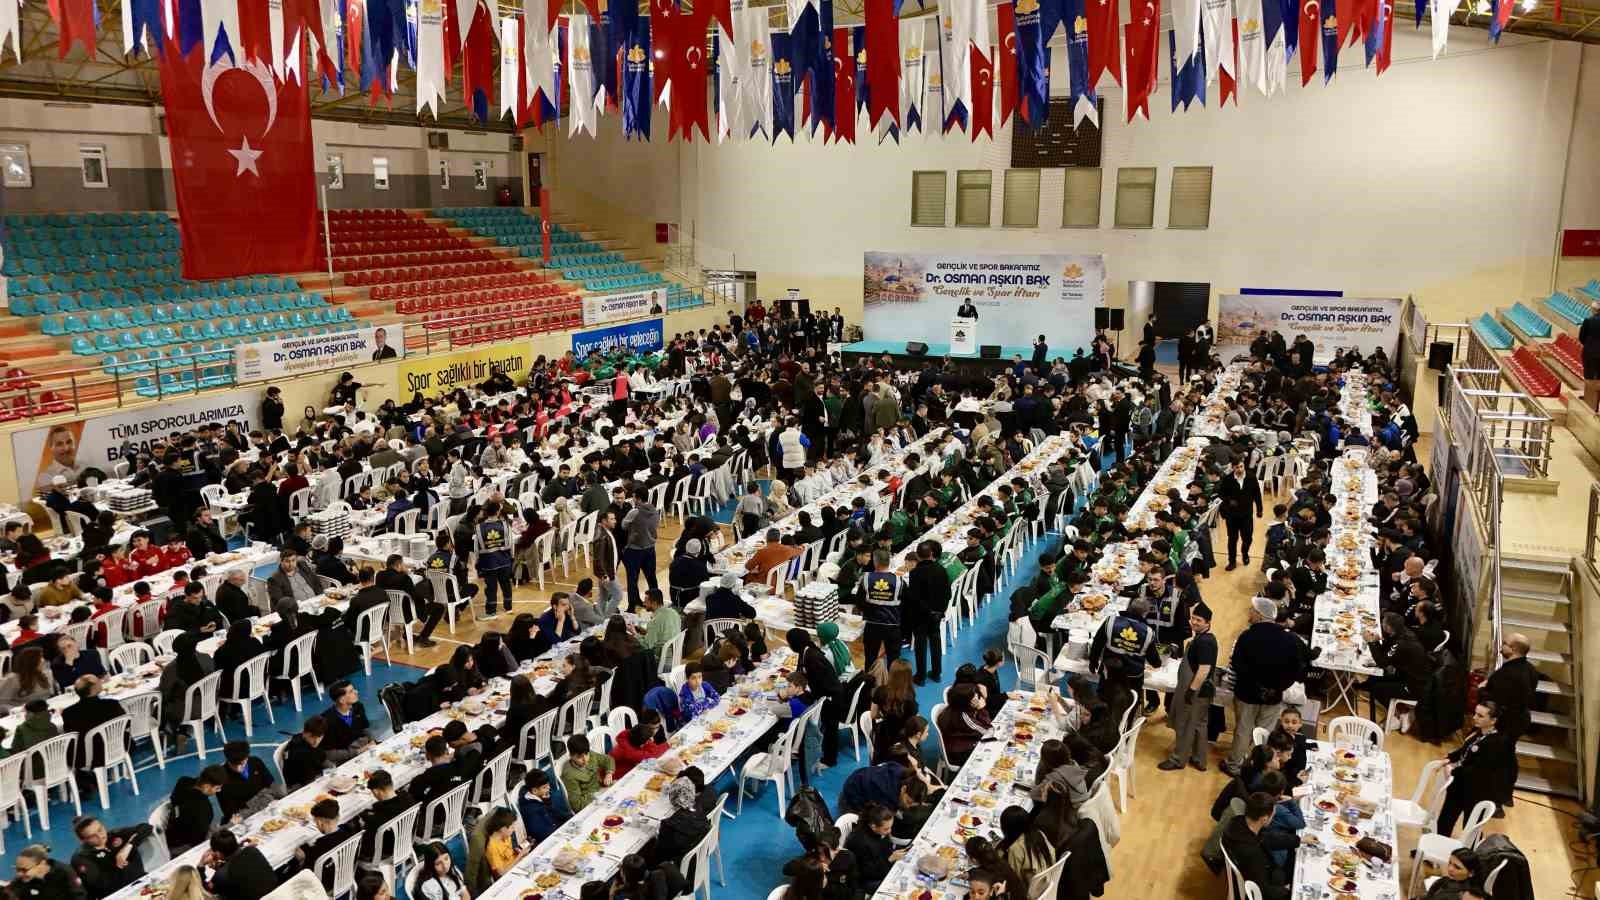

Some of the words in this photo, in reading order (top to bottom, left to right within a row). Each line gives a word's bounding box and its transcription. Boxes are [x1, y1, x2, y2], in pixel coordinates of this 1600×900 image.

[936, 262, 967, 271] GENÇLİK
[979, 263, 998, 271] SPOR
[926, 273, 941, 283] Dr.
[944, 273, 986, 284] OSMAN
[989, 274, 1023, 287] AŞKIN
[1026, 275, 1050, 286] BAK
[933, 285, 971, 297] Gençlik
[986, 286, 1013, 299] Spor
[1281, 312, 1295, 320] Dr.
[1297, 313, 1335, 322] OSMAN
[1337, 314, 1368, 324] AŞKIN
[1370, 314, 1392, 324] BAK
[273, 352, 287, 362] Dr.
[289, 347, 322, 360] OSMAN
[324, 343, 348, 356] AŞKIN
[350, 340, 367, 351] BAK
[576, 341, 592, 361] Spor
[407, 372, 432, 392] Spor
[437, 362, 472, 387] sağlıklı
[473, 359, 487, 379] bir
[489, 355, 523, 376] hayatın
[108, 423, 138, 440] TÜM
[141, 404, 245, 434] SPORCULARIMIZA
